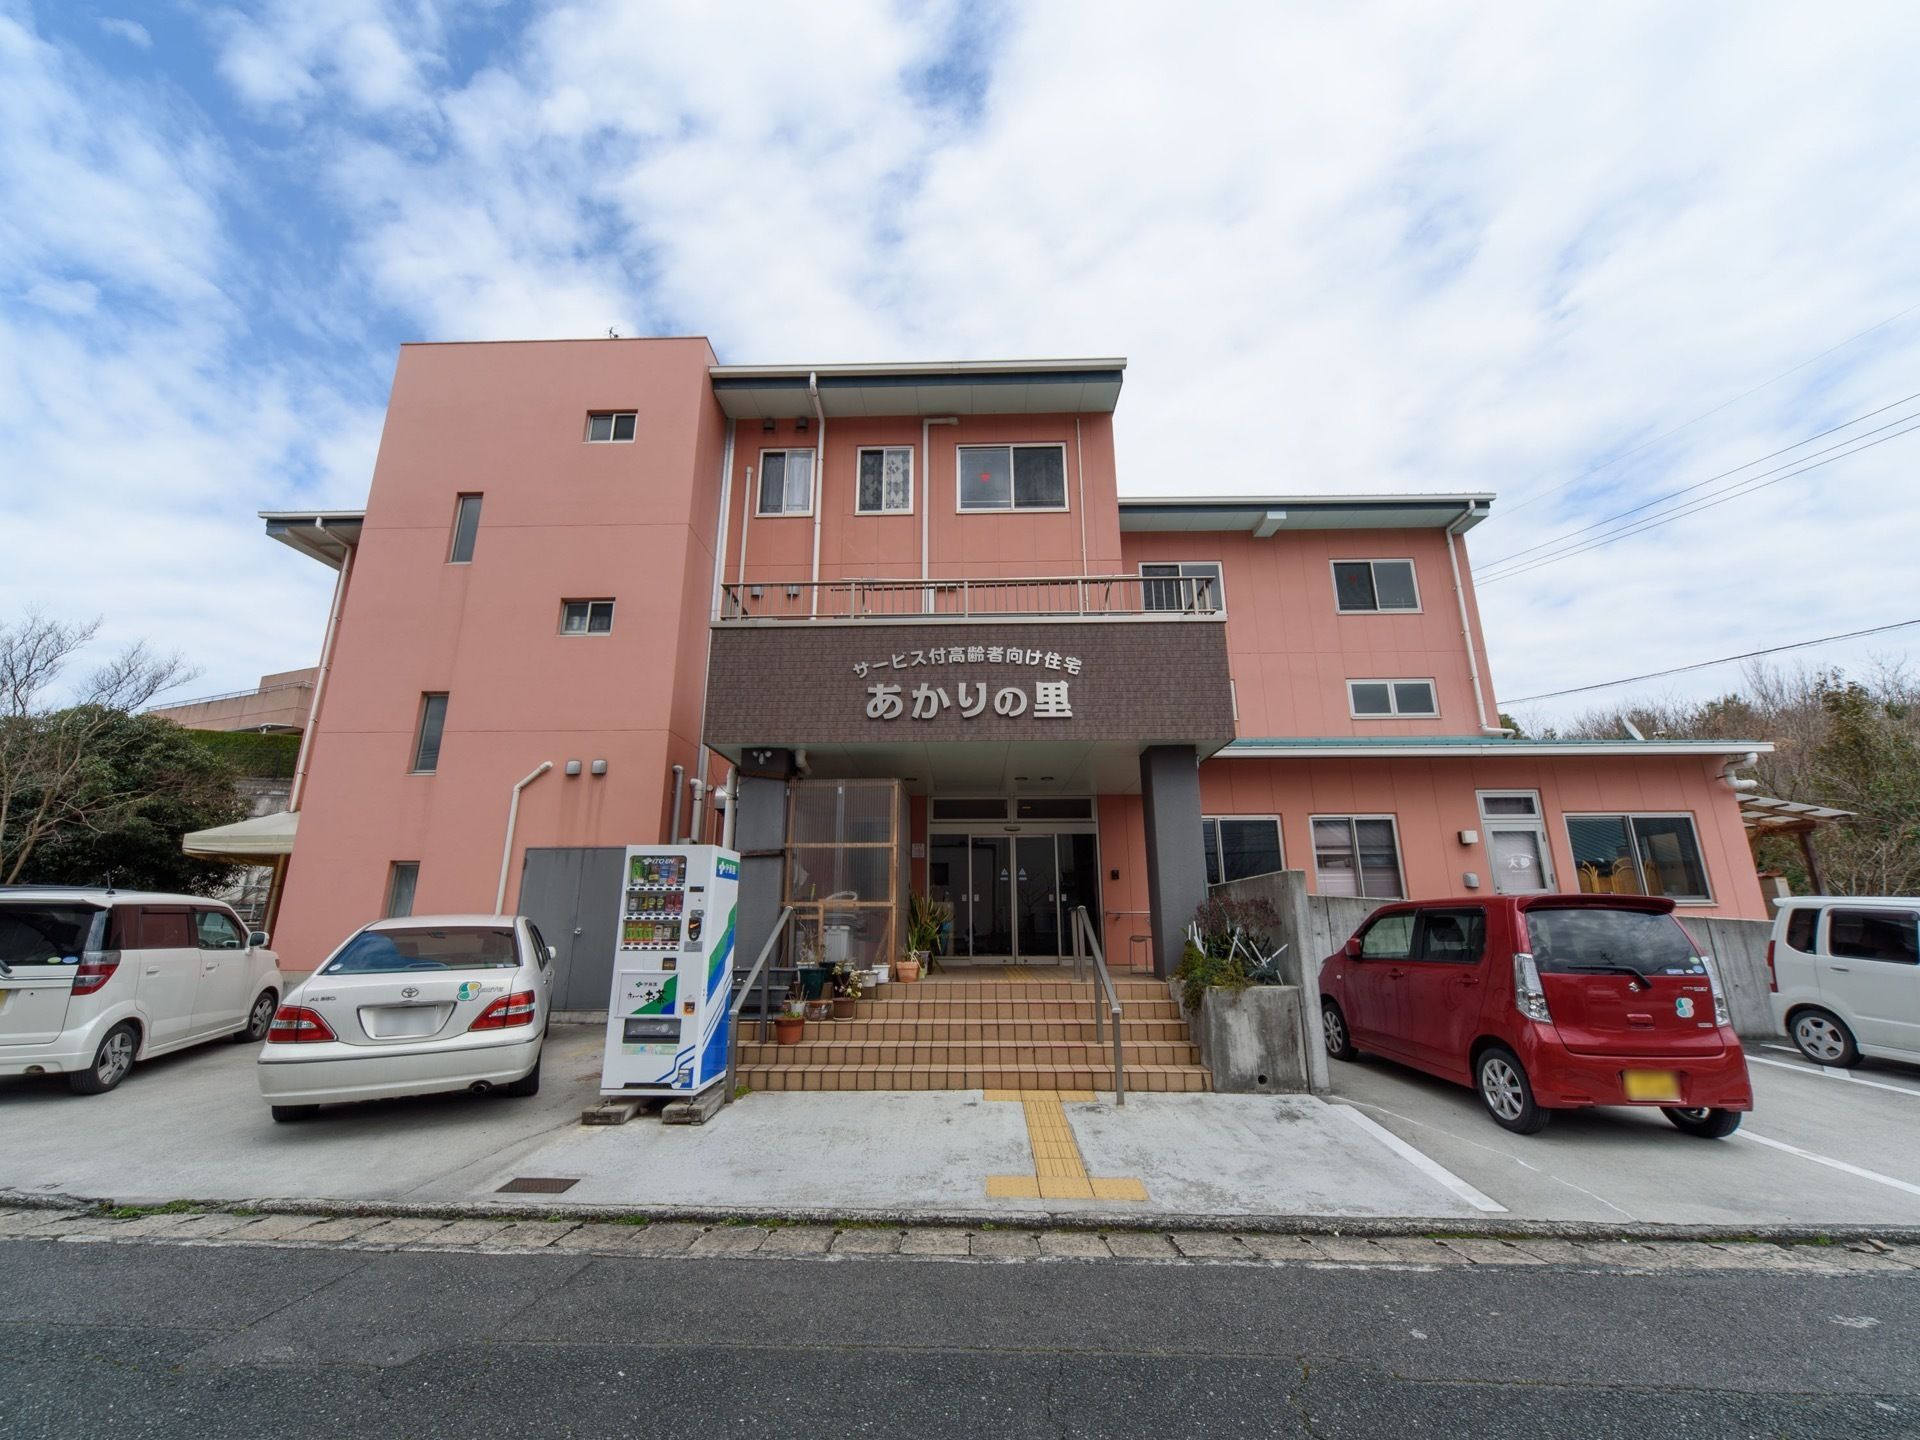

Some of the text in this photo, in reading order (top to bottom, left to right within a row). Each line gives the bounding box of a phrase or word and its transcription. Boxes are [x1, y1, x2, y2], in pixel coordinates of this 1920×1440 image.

[852, 646, 1083, 679] サービス付高齢者向け住宅
[866, 680, 1073, 720] あかりの里
